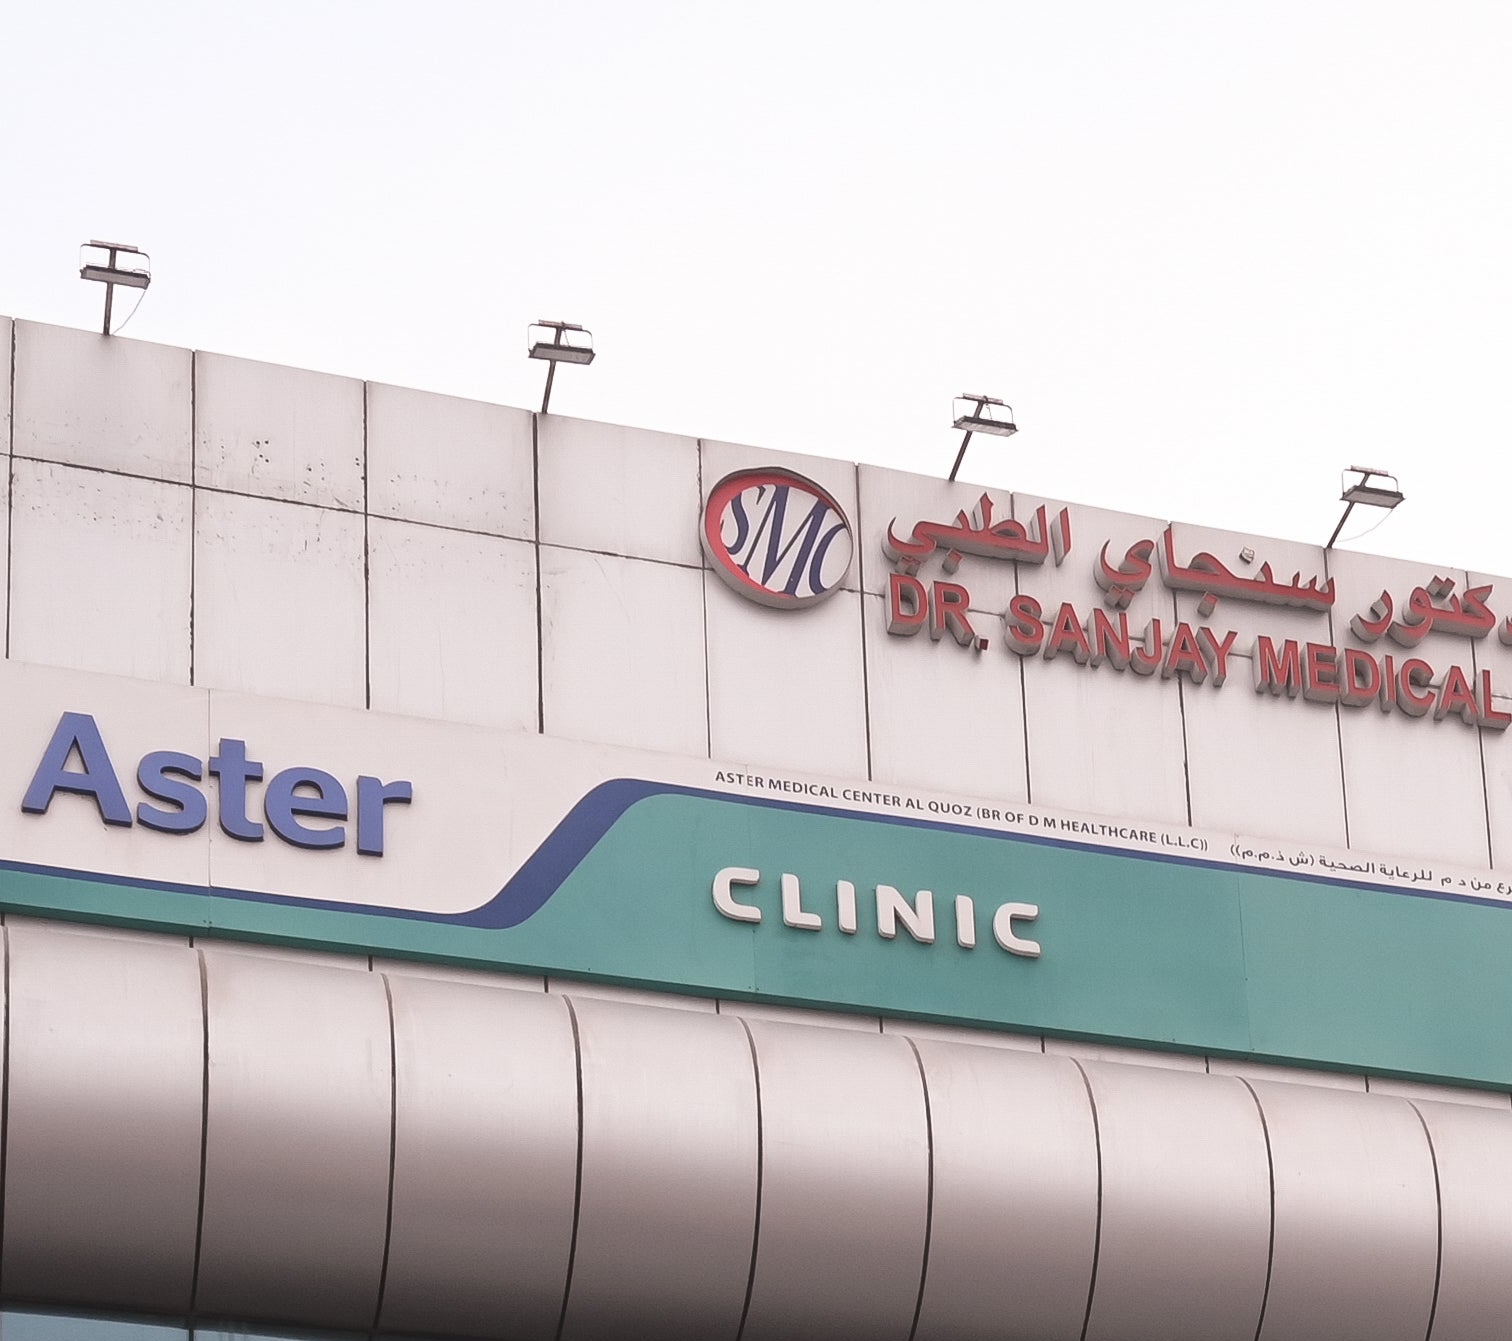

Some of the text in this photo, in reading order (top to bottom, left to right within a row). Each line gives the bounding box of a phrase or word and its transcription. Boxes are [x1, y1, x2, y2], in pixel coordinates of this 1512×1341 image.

[883, 493, 1072, 574] الطبي
[1096, 521, 1338, 615] سنجاي
[887, 574, 991, 652] DR.
[1003, 594, 1237, 686] SANJAY
[1255, 633, 1512, 733] MEDICAL
[20, 710, 413, 858] Aster
[714, 770, 1158, 845] ASTER MEDICAL CENTER AL QUOZ (BR OF D M HEALTHCARE
[710, 865, 1042, 960] CLINIC
